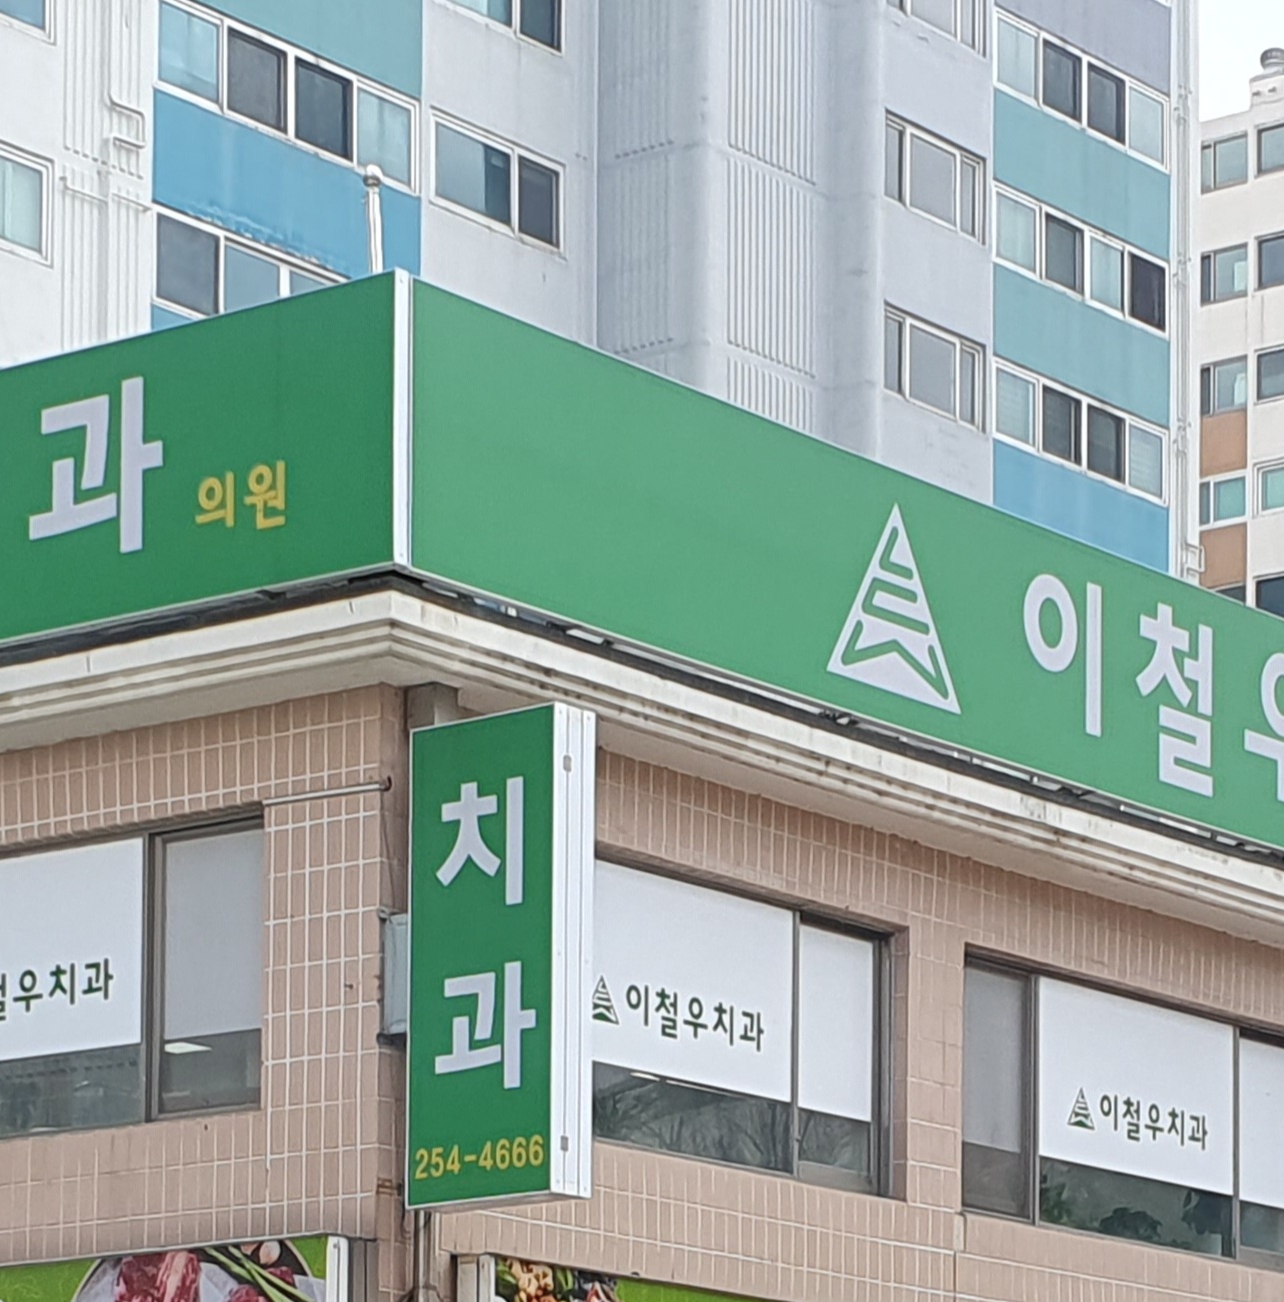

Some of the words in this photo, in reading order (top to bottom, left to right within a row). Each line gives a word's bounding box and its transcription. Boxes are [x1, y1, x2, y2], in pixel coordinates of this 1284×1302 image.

[193, 460, 288, 531] 의원
[434, 776, 537, 1090] 치과
[625, 984, 765, 1052] 이철우치과
[1099, 1093, 1210, 1151] 이철우치과
[415, 1134, 545, 1180] 254-4666
